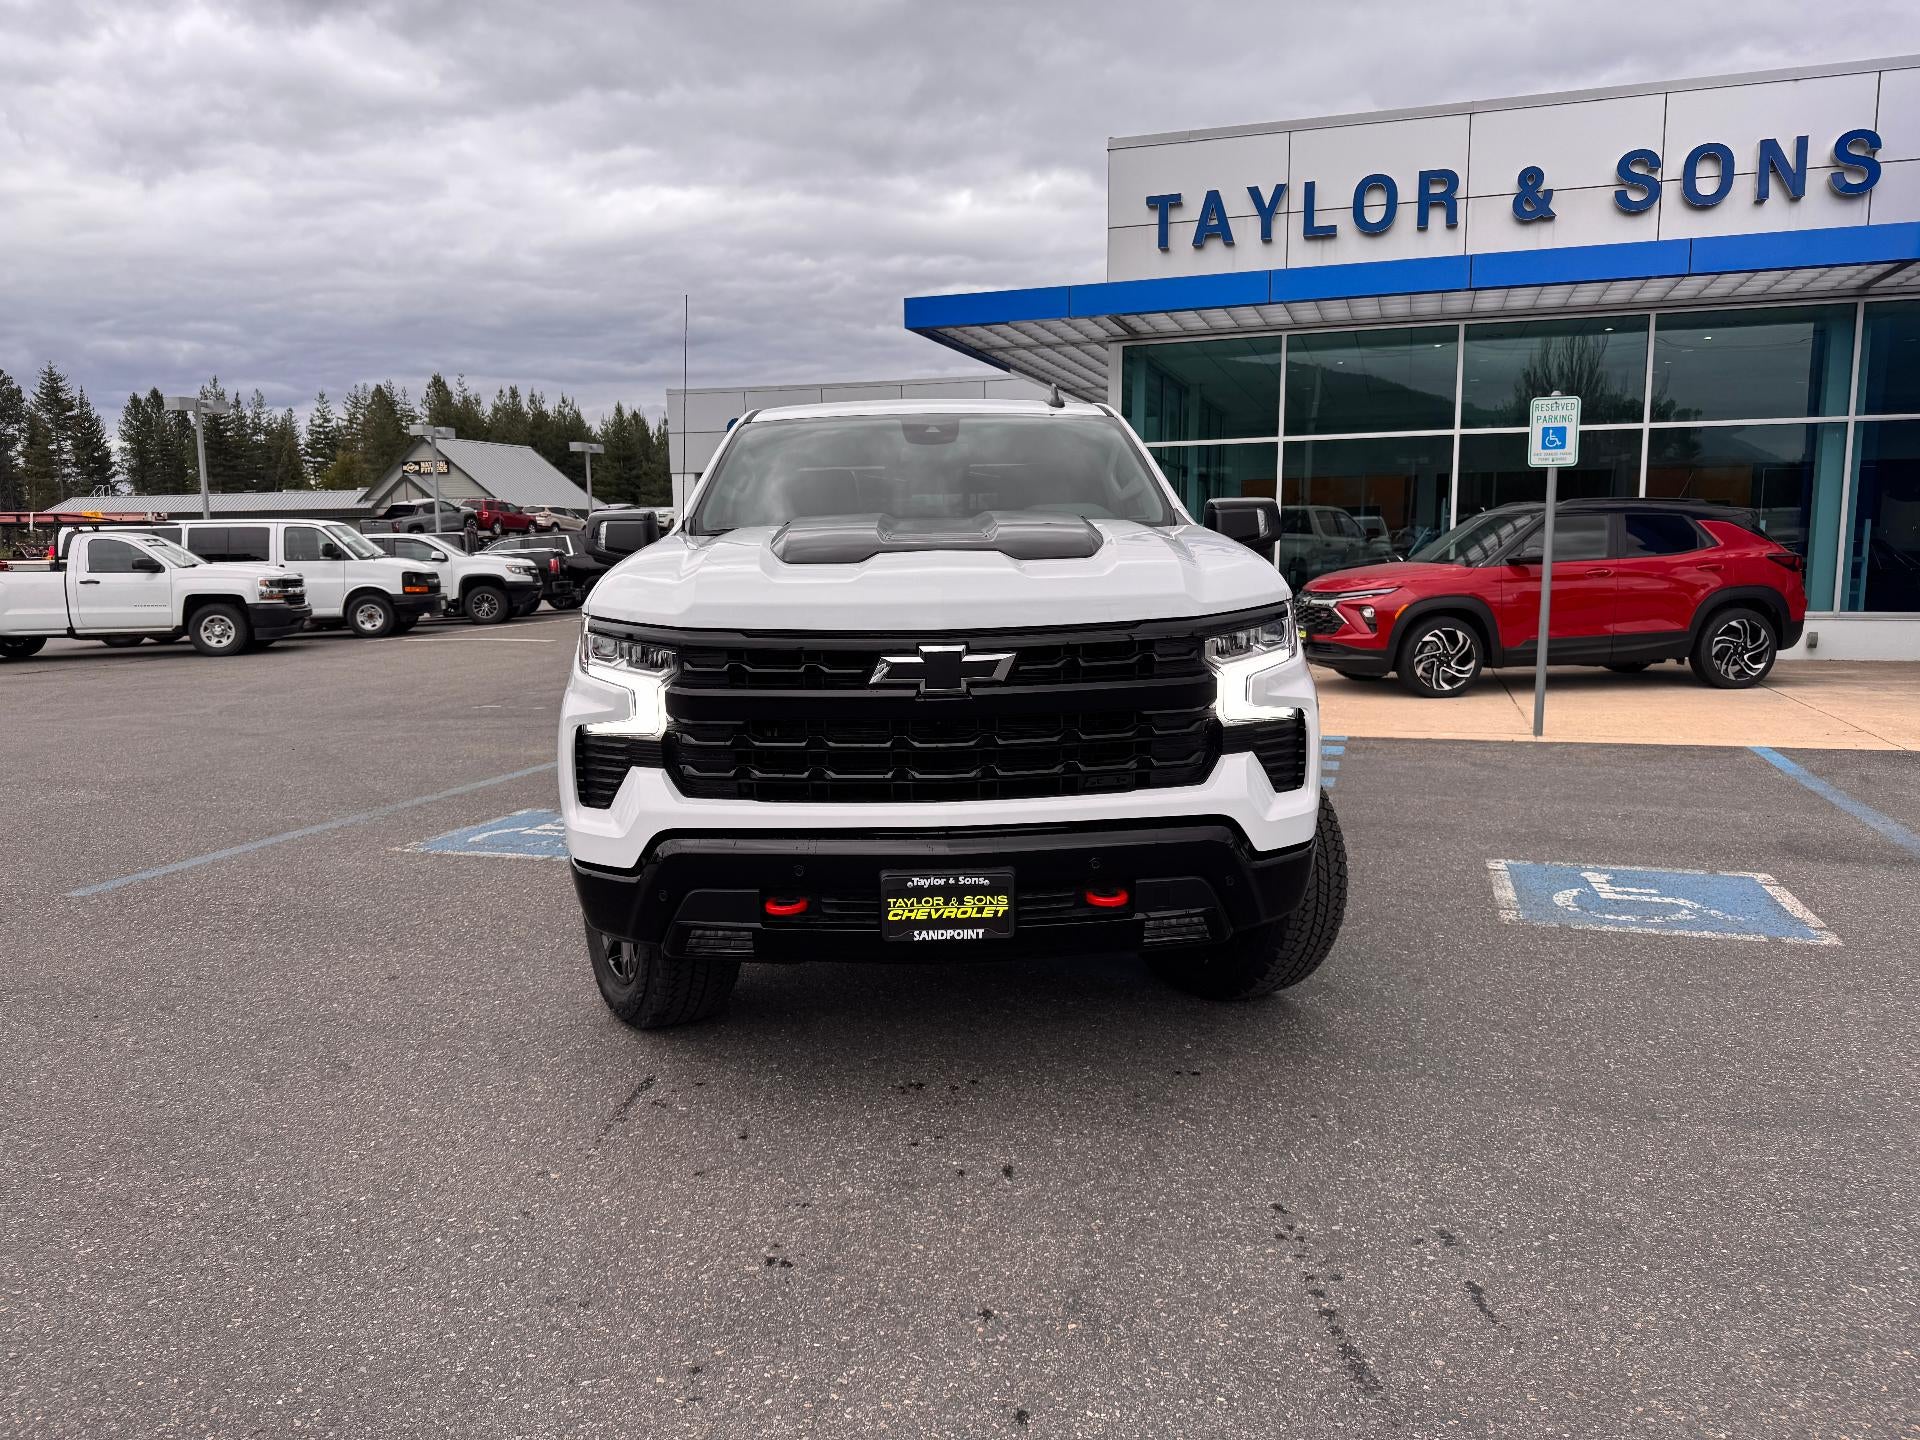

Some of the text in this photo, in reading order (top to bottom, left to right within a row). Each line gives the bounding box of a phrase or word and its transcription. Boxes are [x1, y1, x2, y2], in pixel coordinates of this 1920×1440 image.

[1145, 128, 1883, 251] TAYLOR & SONS
[1535, 402, 1576, 412] RESERVED
[1536, 414, 1573, 424] PARKING
[911, 877, 946, 888] Taylor
[958, 876, 985, 885] Sons
[887, 895, 1008, 908] TAYLOR & SONS
[887, 906, 1009, 921] CHEVROLET
[913, 928, 985, 941] SANDPOINT
